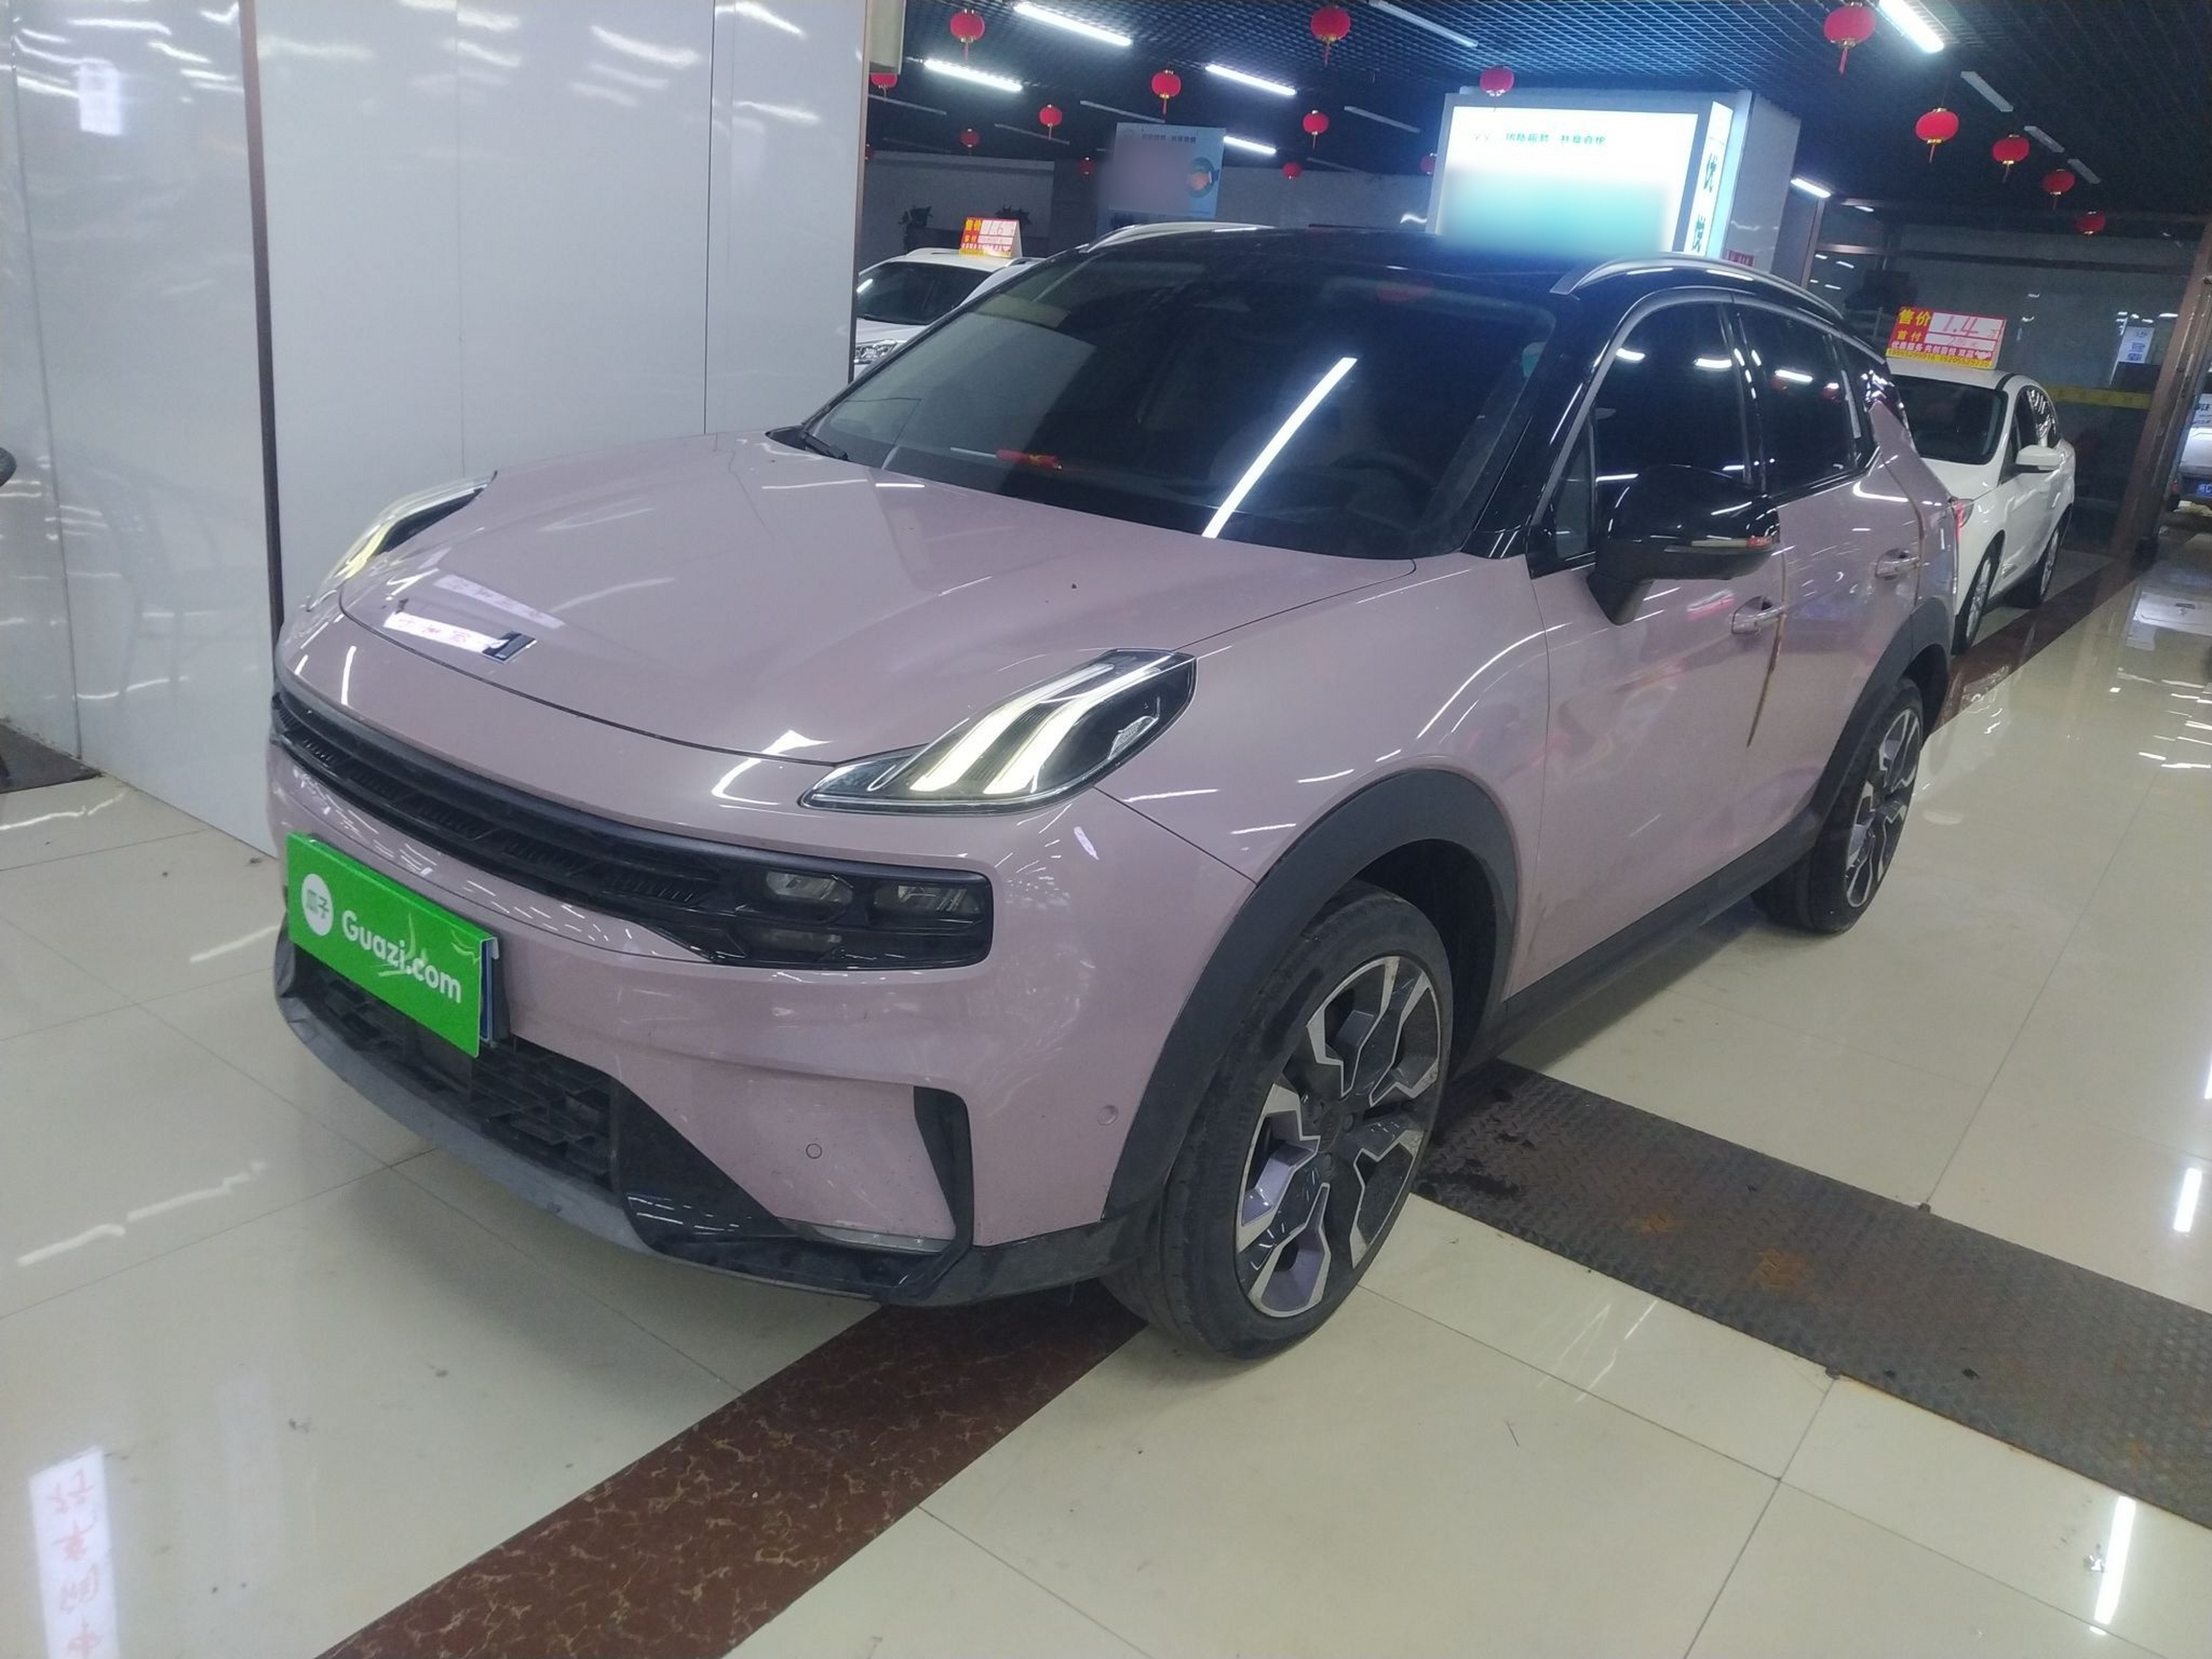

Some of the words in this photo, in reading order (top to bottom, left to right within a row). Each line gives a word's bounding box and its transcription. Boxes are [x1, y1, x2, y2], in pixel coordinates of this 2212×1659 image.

[1898, 308, 1931, 327] 售价
[1897, 329, 1922, 342] 首付
[341, 910, 462, 1004] Guazi.com
